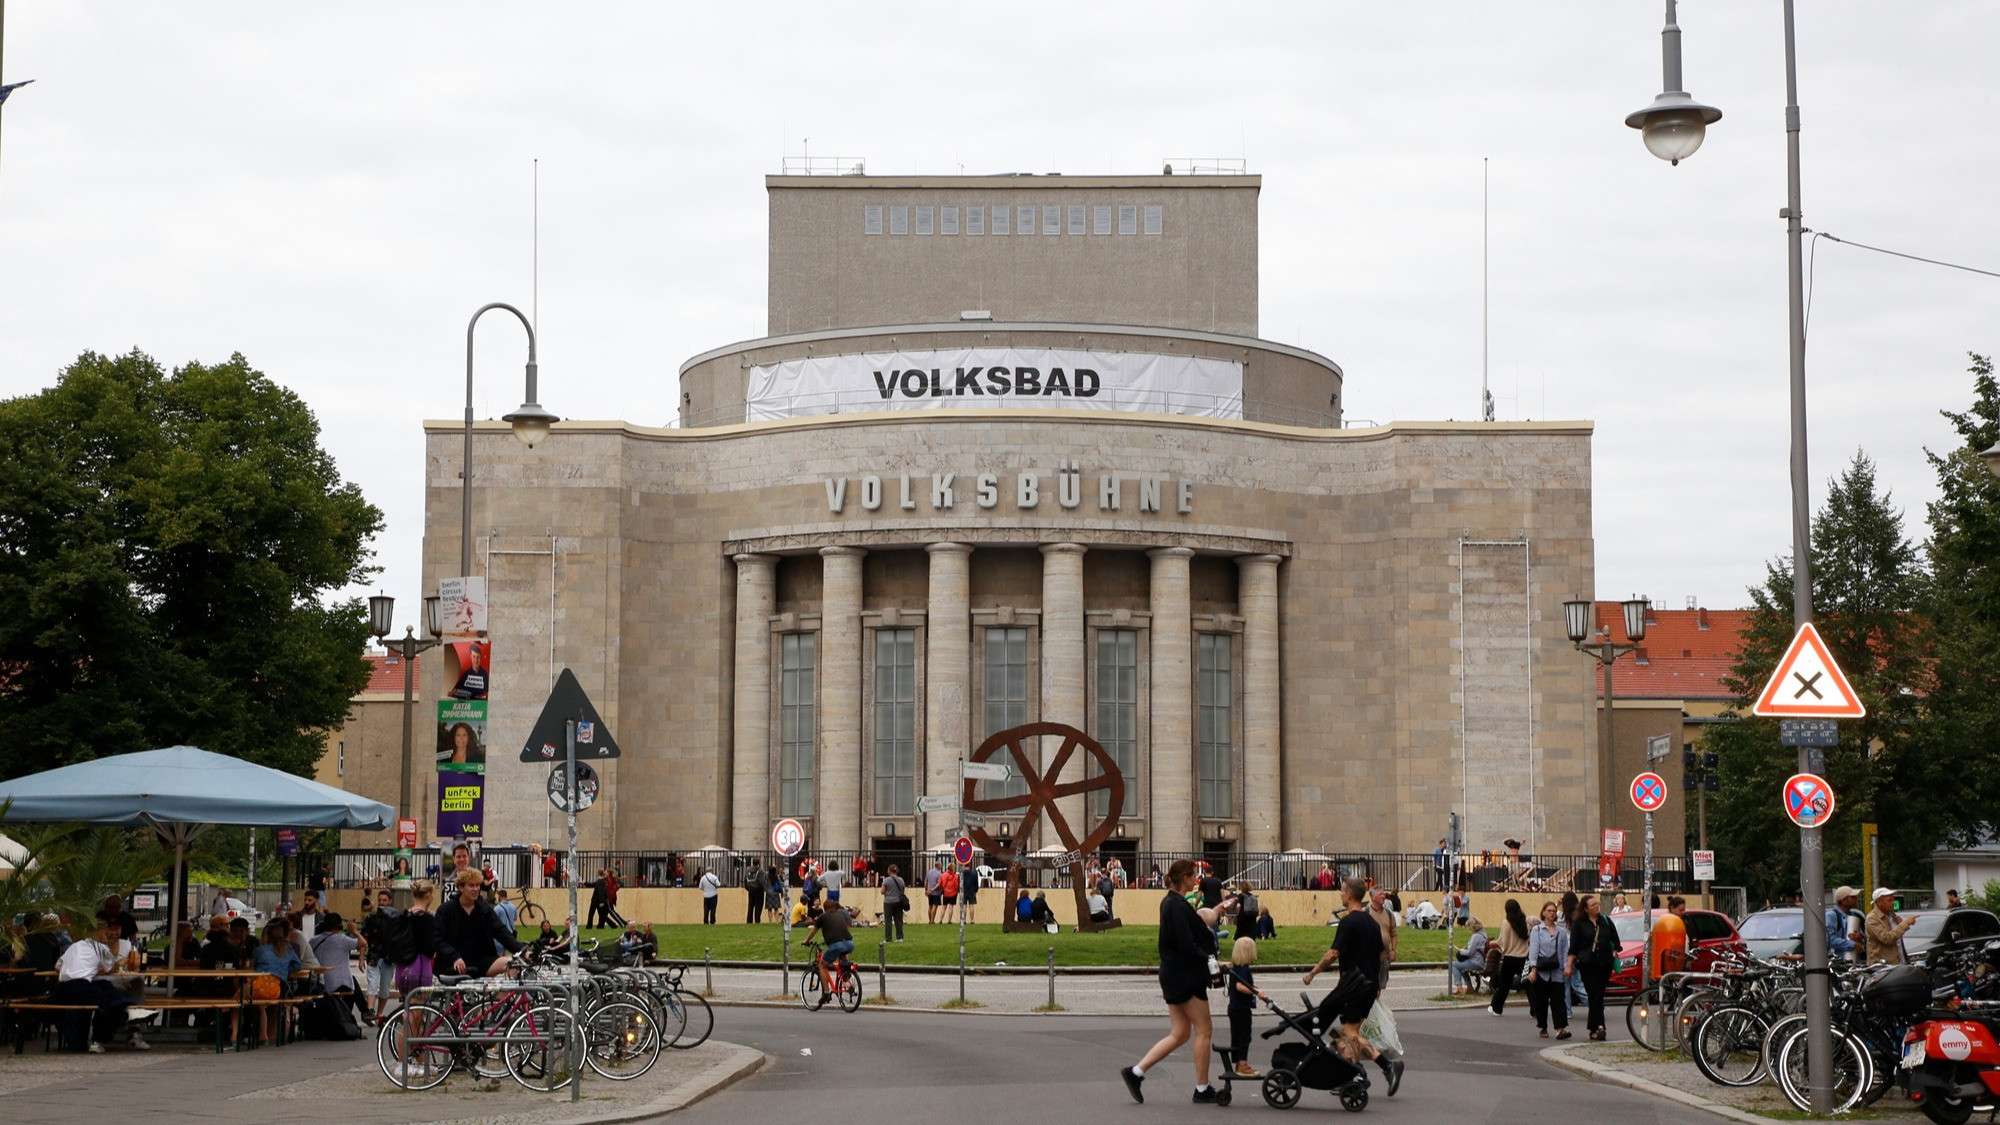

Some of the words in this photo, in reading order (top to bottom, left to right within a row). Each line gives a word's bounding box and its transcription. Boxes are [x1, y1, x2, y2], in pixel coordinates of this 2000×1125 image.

[873, 366, 1100, 399] VOLKSBAD
[825, 459, 1193, 515] VOLKSBÜHNE
[452, 702, 471, 710] KATJA
[441, 710, 483, 718] ZIMMERMANN
[444, 800, 470, 809] berlin
[462, 824, 480, 833] Volt
[780, 829, 797, 845] 30
[1942, 1041, 1968, 1050] emmy
